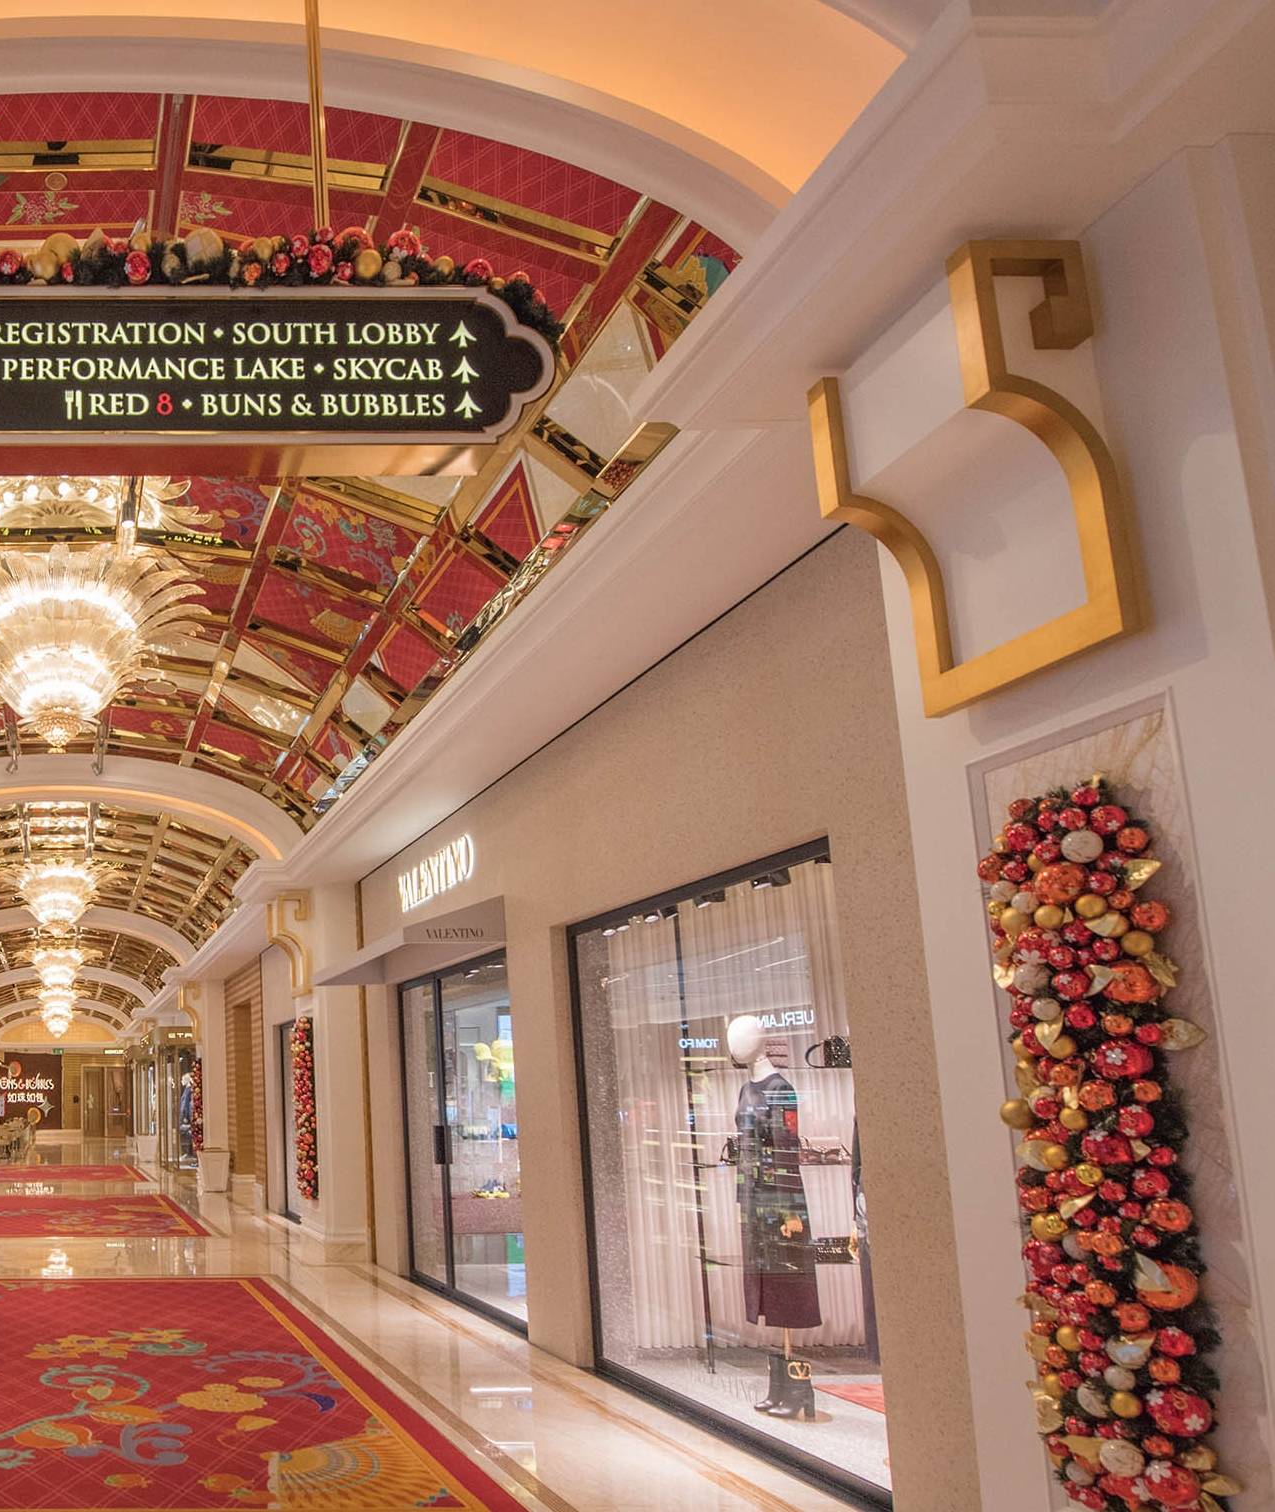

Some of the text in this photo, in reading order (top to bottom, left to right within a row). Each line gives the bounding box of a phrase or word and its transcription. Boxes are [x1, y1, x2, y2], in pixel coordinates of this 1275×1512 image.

[233, 323, 337, 344] SOUTH
[347, 323, 440, 344] LOBBY
[2, 358, 443, 380] PERFORMANCE LAKE SKYCAB
[89, 393, 445, 416] RED 8 BUNS & BUBBLES
[397, 832, 474, 913] VALENTINO
[425, 927, 484, 940] VALENTINO
